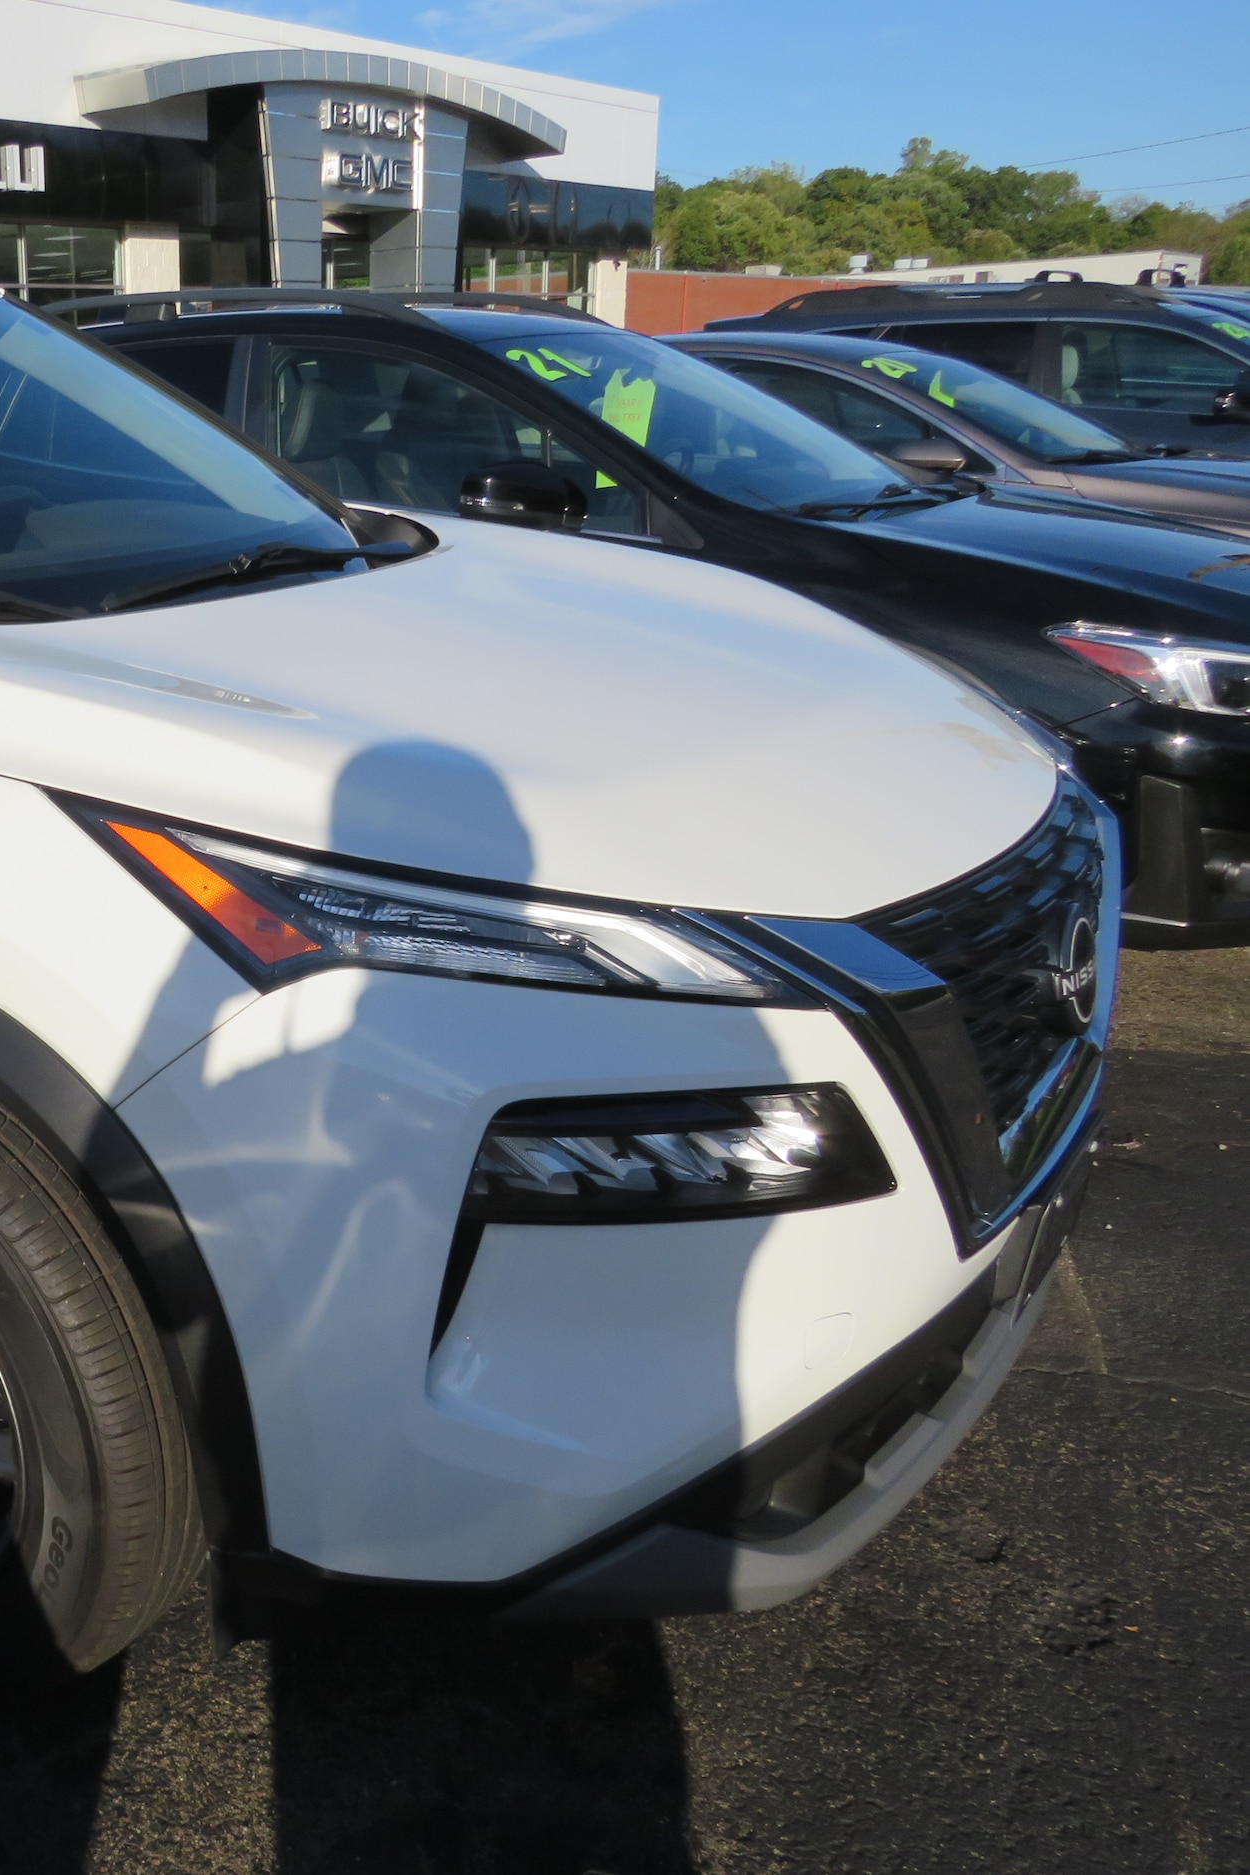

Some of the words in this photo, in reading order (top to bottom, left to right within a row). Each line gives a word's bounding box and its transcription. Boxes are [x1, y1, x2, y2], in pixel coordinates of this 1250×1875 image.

[319, 98, 424, 142] BUICK
[322, 151, 414, 191] GMC
[505, 348, 592, 381] 21
[1061, 960, 1095, 996] NISS
